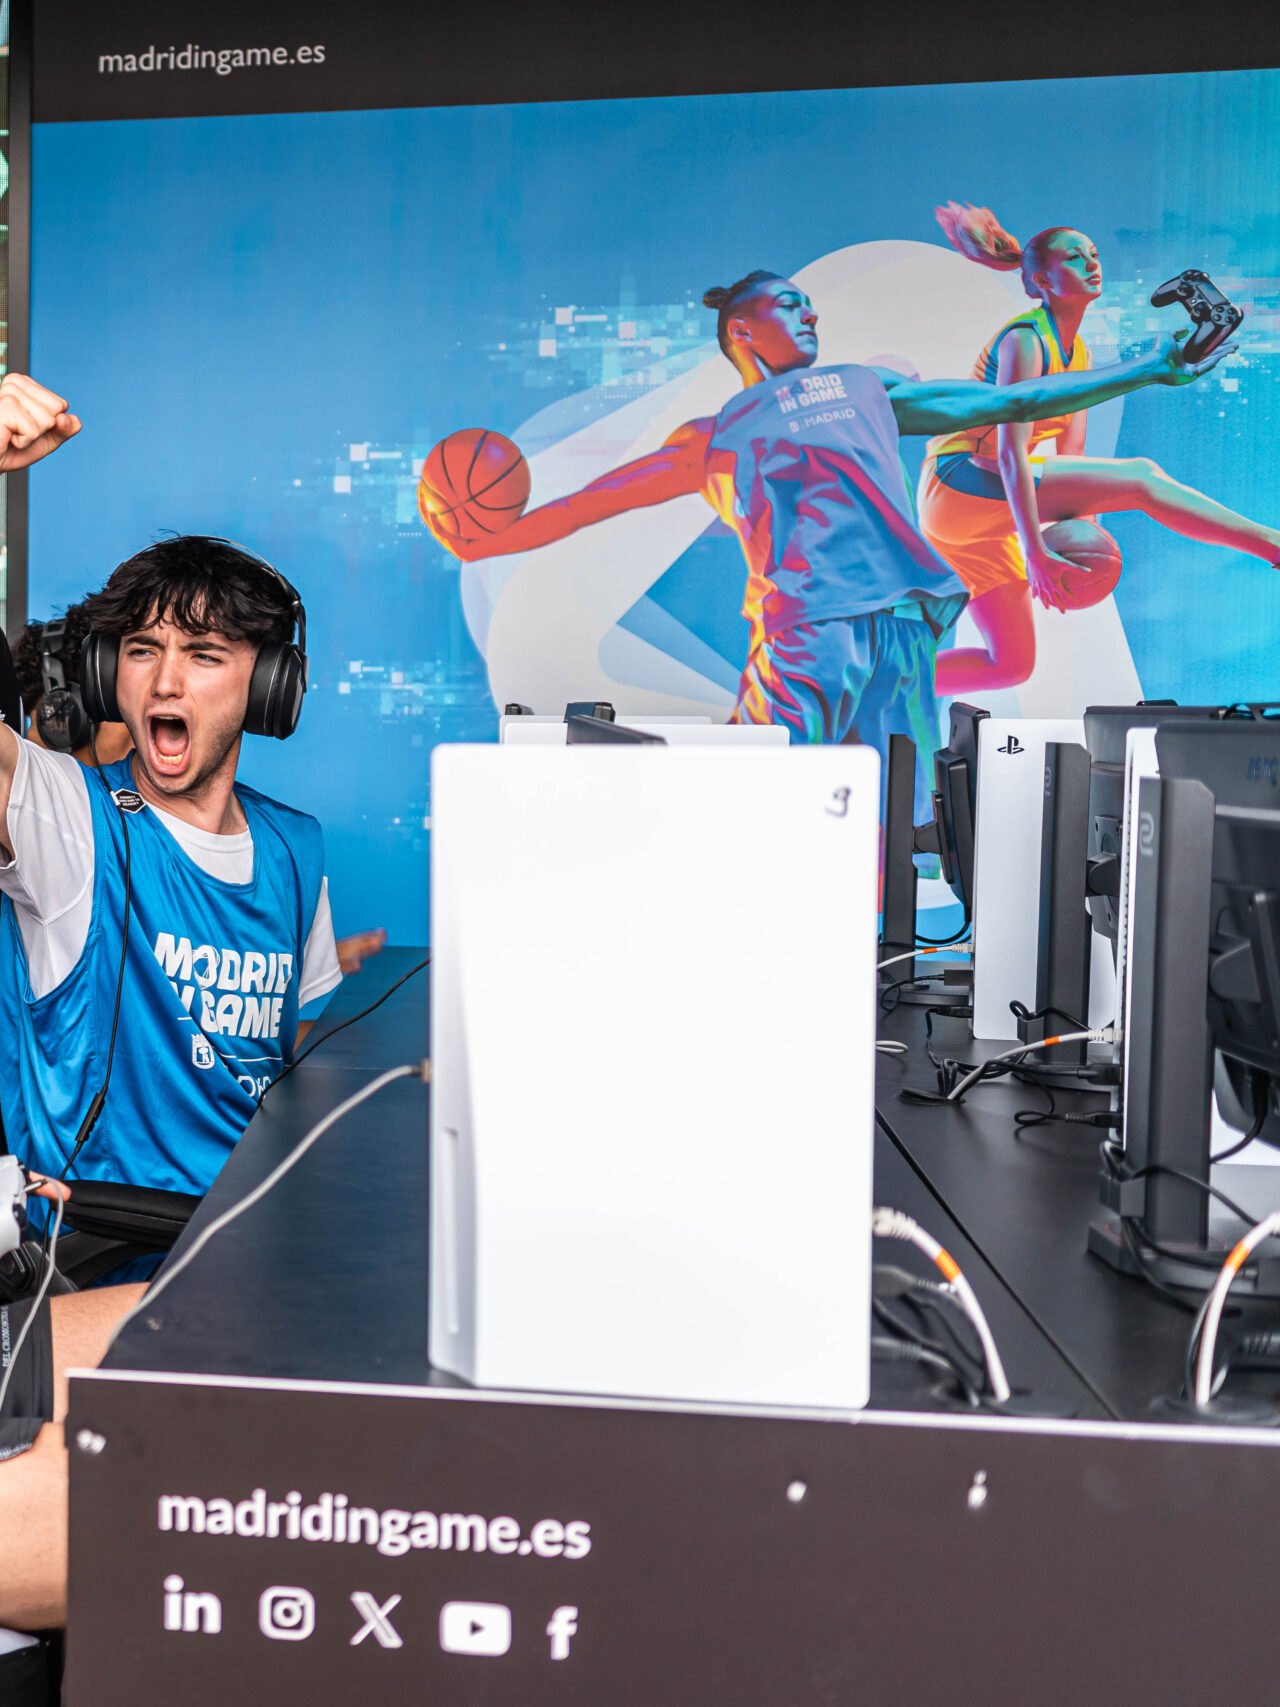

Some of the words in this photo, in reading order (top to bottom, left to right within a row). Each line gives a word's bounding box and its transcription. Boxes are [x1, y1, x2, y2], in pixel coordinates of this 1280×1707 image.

[98, 43, 326, 76] madridingame.es
[779, 397, 799, 414] IN
[799, 386, 848, 407] GAME
[805, 408, 856, 428] MADRID
[200, 990, 284, 1039] GAME
[158, 1488, 592, 1559] madridingame.es
